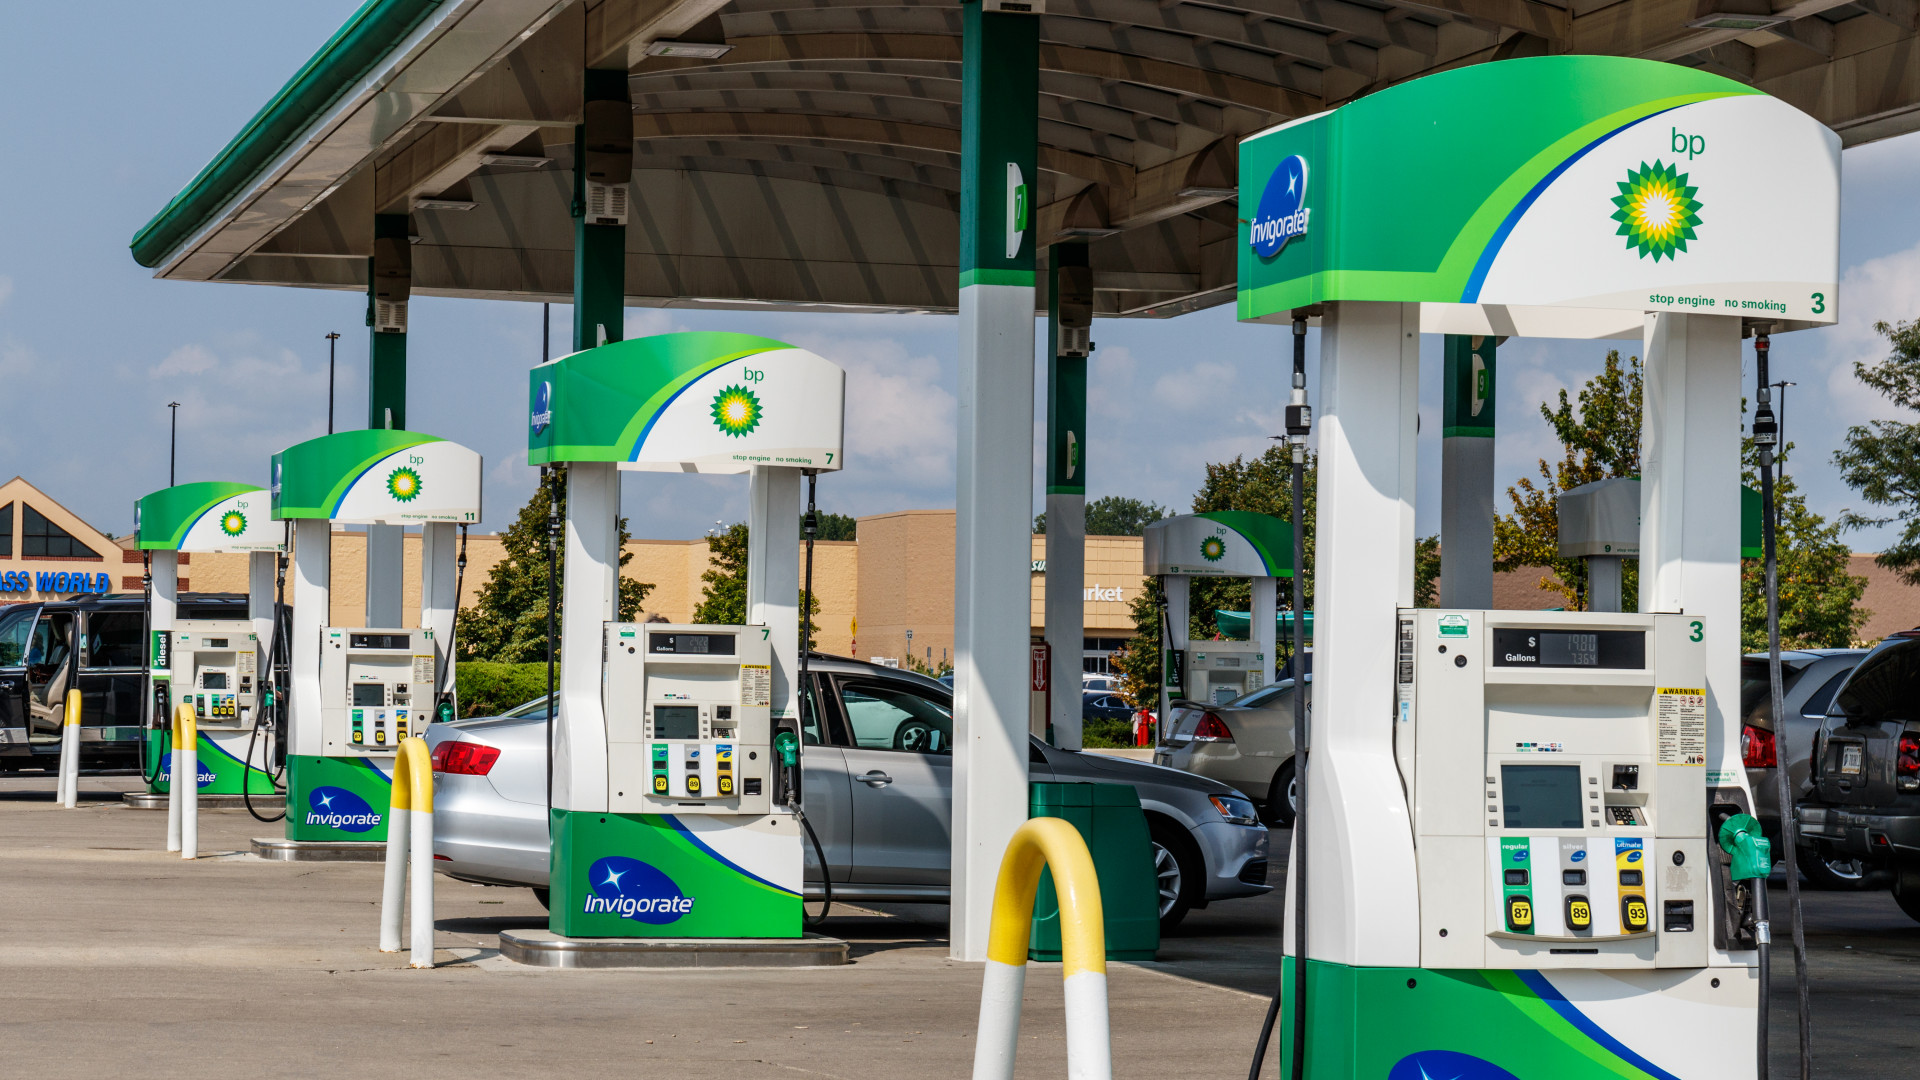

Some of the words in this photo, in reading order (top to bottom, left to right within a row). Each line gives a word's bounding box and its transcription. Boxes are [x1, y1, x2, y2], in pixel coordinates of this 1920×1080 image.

[1671, 126, 1706, 161] bp
[1249, 208, 1306, 248] Invigorate
[1649, 293, 1675, 306] stop
[1677, 294, 1716, 308] engine
[1724, 299, 1739, 308] no
[1741, 299, 1787, 313] smoking
[1810, 292, 1826, 315] 3
[744, 366, 764, 385] bp
[409, 453, 424, 466] bp
[732, 454, 748, 462] stop
[748, 454, 771, 462] engine
[785, 456, 812, 465] smoking
[825, 452, 834, 465] 7
[237, 500, 249, 509] bp
[464, 512, 475, 521] 11
[1216, 526, 1227, 536] bp
[1604, 544, 1612, 553] 9
[1031, 560, 1046, 572] SU
[0, 570, 30, 592] SS
[36, 571, 110, 594] WORLD
[423, 631, 434, 640] 11
[761, 629, 770, 641] 7
[1689, 620, 1704, 643] 3
[1528, 636, 1536, 648] $
[157, 634, 167, 666] diesel
[1505, 653, 1536, 663] Gallons
[1667, 688, 1700, 696] WARNING
[306, 811, 382, 828] Invigorate
[1502, 843, 1529, 851] regular
[584, 894, 693, 918] Invigorate
[1514, 907, 1529, 919] 87
[1572, 907, 1588, 919] 89
[1630, 908, 1645, 919] 93
